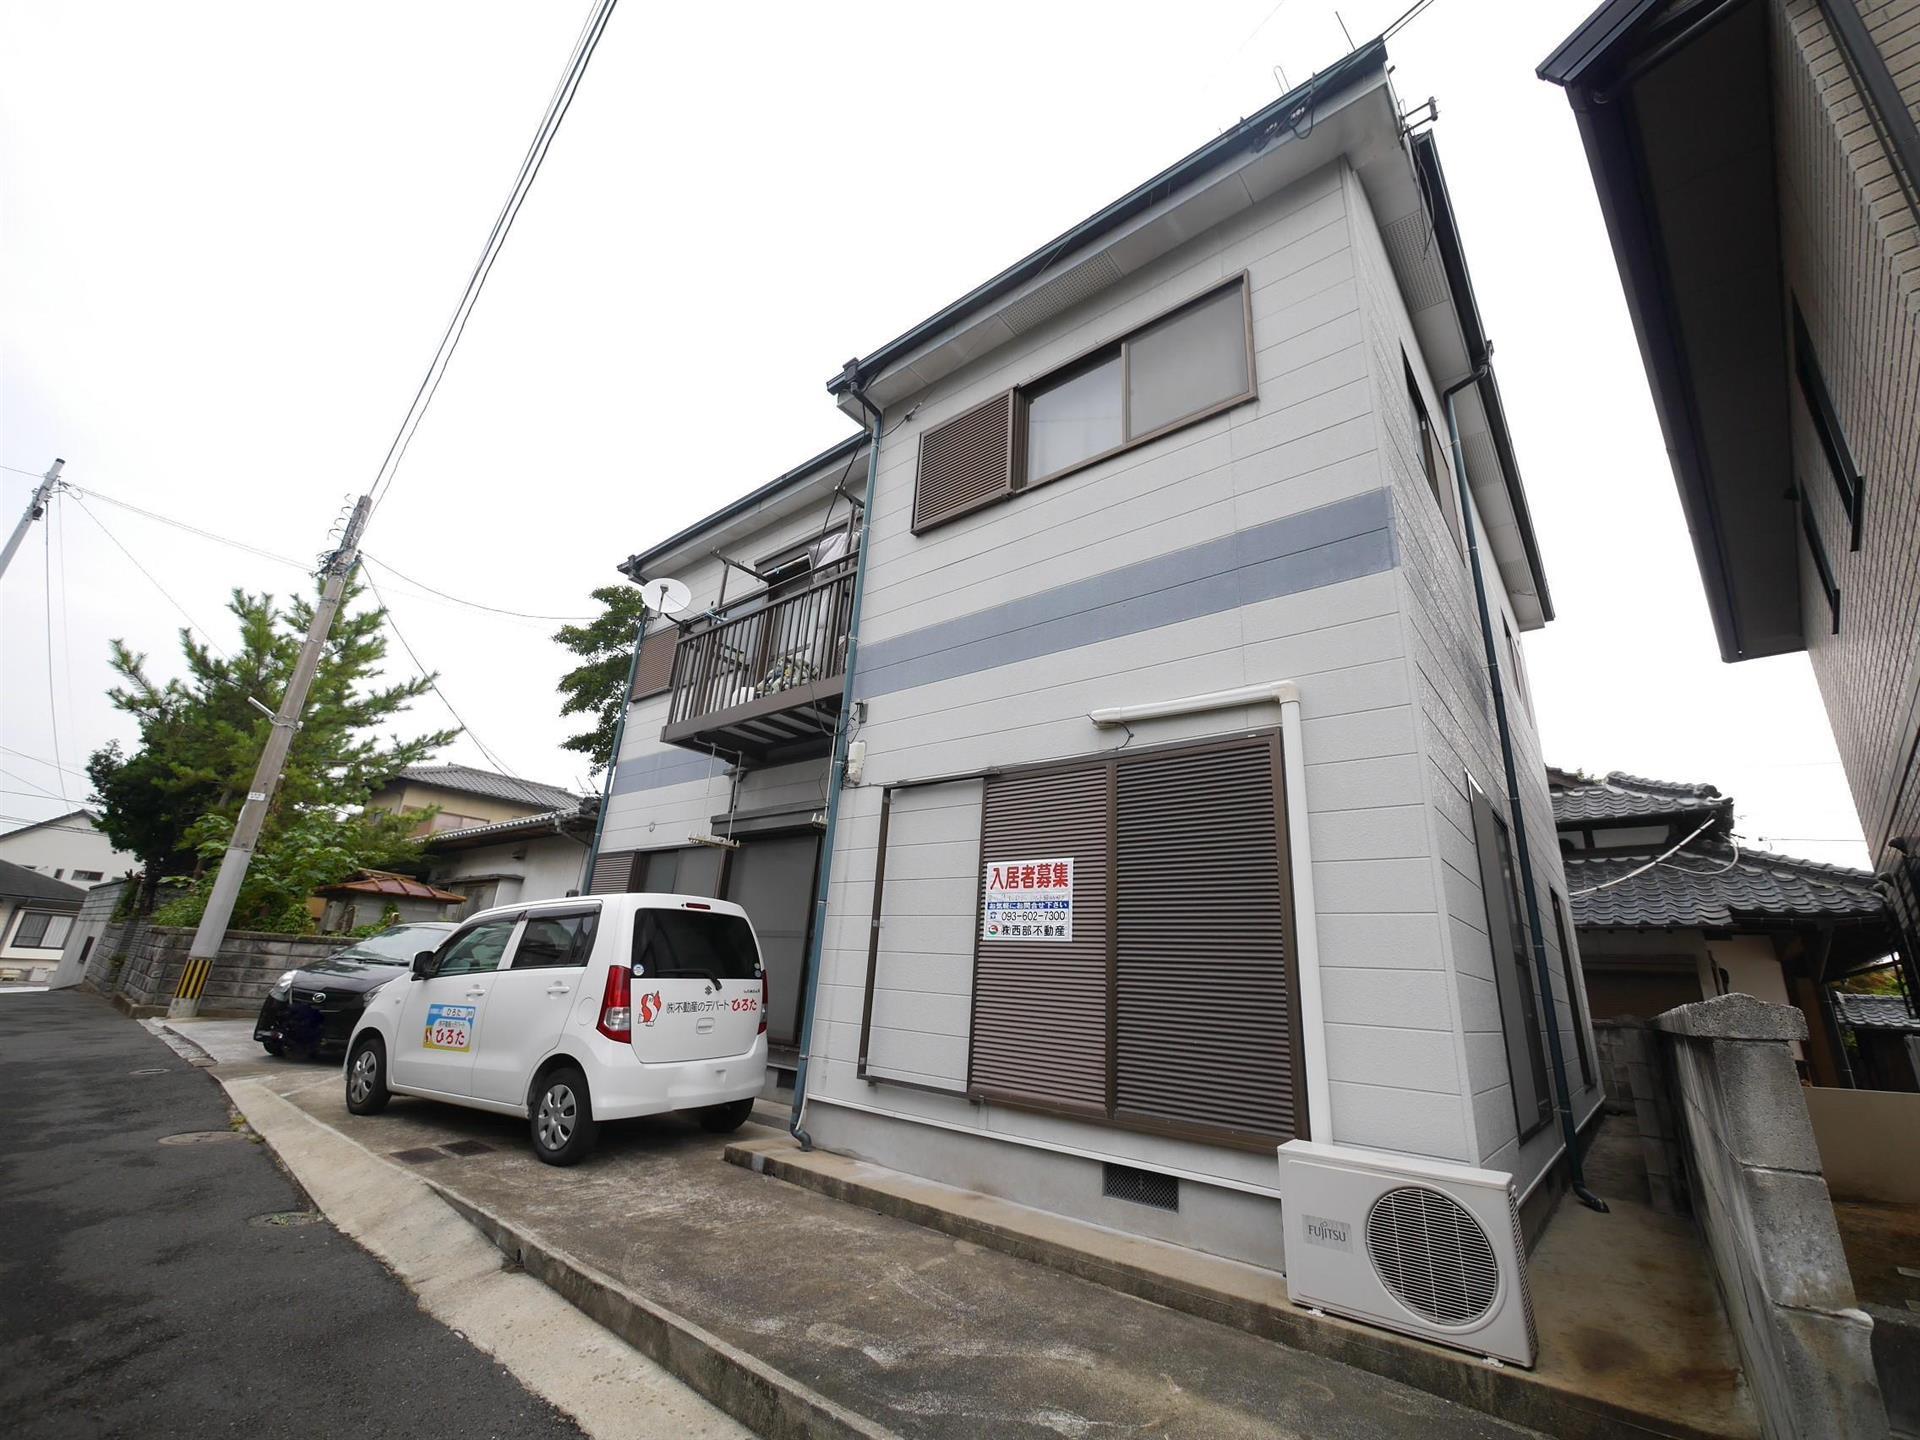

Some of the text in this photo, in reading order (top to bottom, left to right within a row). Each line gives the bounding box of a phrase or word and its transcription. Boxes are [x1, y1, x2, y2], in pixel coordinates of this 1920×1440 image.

[990, 863, 1069, 890] 入居者募集
[1001, 911, 1066, 921] 093-602-7300
[731, 998, 757, 1012] ひろた
[436, 1028, 465, 1046] ひろた
[1308, 1221, 1346, 1242] FUJITSU
